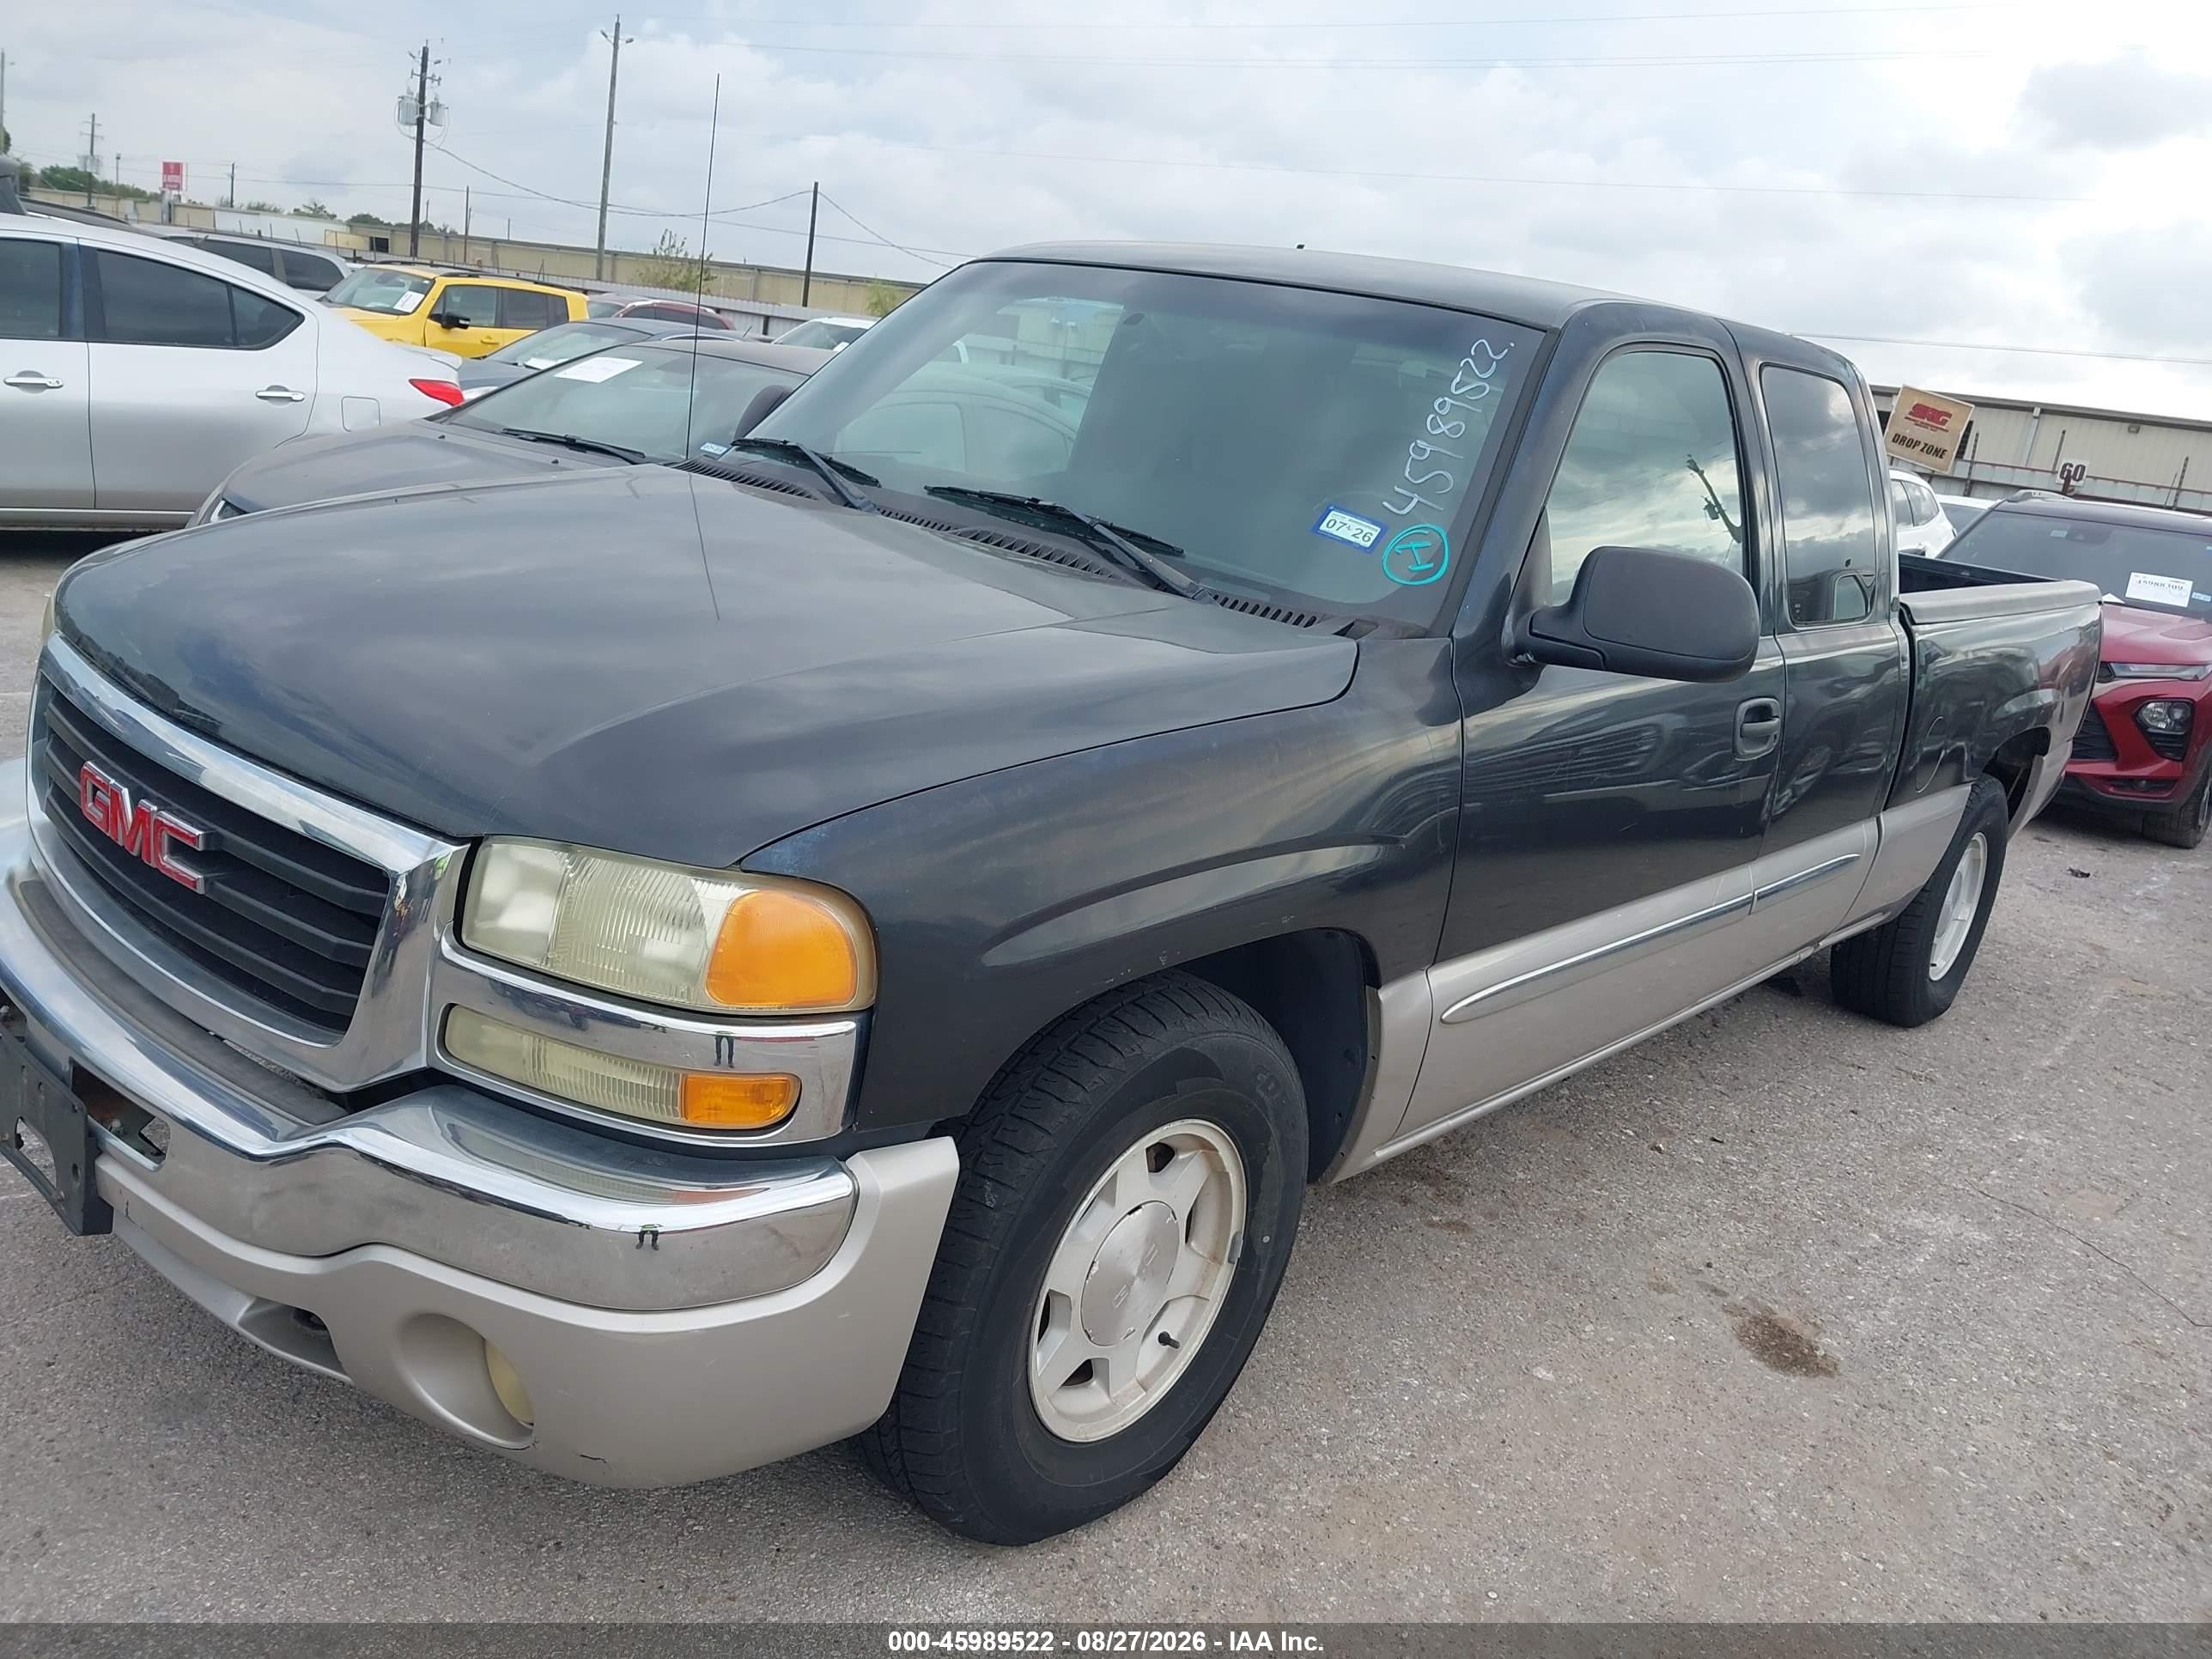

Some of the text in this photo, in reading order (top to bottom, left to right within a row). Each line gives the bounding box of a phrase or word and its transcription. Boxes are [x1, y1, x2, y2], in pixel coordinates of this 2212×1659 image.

[1892, 433, 1948, 459] DROP ZONE
[2059, 463, 2086, 483] 60
[1326, 519, 1347, 532] 07
[1351, 528, 1374, 543] 26
[80, 761, 206, 895] GMC
